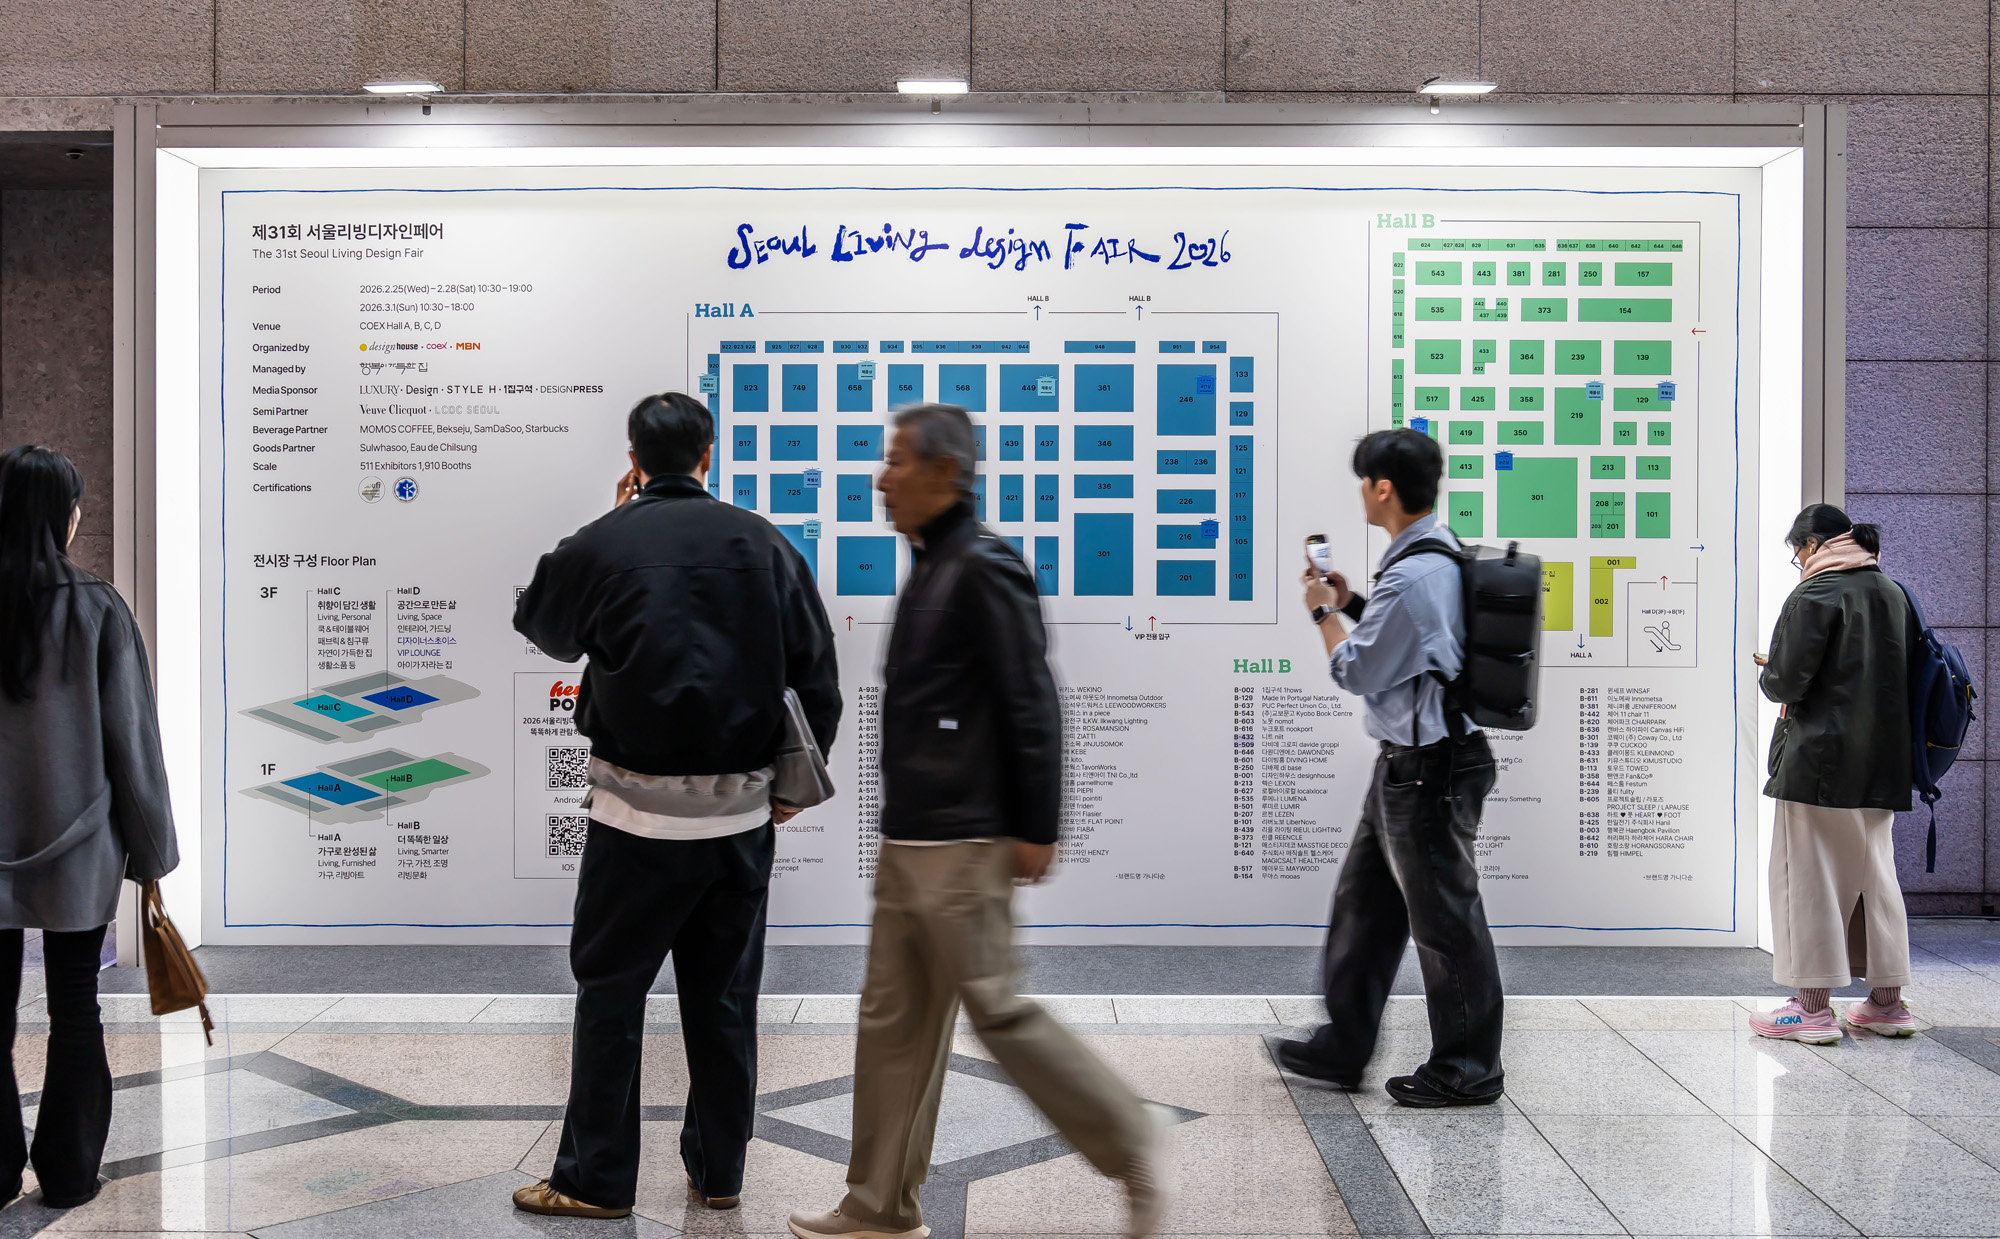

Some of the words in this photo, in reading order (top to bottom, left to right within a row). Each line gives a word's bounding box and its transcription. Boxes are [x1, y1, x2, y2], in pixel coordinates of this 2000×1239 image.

[1377, 213, 1417, 228] Hall
[1422, 214, 1434, 228] B
[252, 224, 300, 240] 제31회
[307, 223, 442, 240] 서울리빙디자인페어
[253, 249, 272, 258] The
[276, 249, 297, 258] 31st
[300, 249, 328, 258] Seoul
[333, 249, 362, 260] Living
[366, 248, 401, 260] Design
[405, 248, 423, 257] Fair
[1167, 230, 1231, 270] 2026
[360, 303, 418, 313] 2026.3.1(Sun)
[695, 303, 734, 317] Hall
[740, 304, 754, 317] A
[360, 322, 385, 330] COEX
[387, 322, 402, 330] Hall
[404, 322, 412, 331] A,
[414, 322, 422, 331] B,
[424, 322, 432, 331] C,
[253, 344, 297, 353] Organized
[299, 344, 309, 353] by
[253, 365, 293, 375] Managed
[295, 365, 306, 374] by
[253, 386, 279, 394] Media
[281, 386, 318, 396] Sponsor
[360, 385, 399, 396] LUXURY
[406, 385, 438, 396] Design
[447, 385, 483, 394] STYLE
[489, 385, 496, 393] H
[253, 407, 274, 415] Semi
[276, 407, 308, 415] Partner
[360, 405, 386, 414] Veuve
[389, 404, 426, 416] Clicquot
[435, 405, 462, 415] LCDC
[466, 405, 500, 414] SEOUL
[253, 426, 294, 436] Beverage
[360, 425, 396, 433] MOMOS
[398, 425, 435, 435] COFFEE,
[437, 425, 472, 434] Bekseju,
[474, 424, 523, 434] SamDaSoo,
[526, 424, 569, 432] Starbucks
[253, 444, 281, 452] Goods
[283, 444, 315, 452] Partner
[360, 444, 408, 453] Sulwhasoo,
[411, 443, 426, 451] Eau
[440, 443, 477, 453] Chilsung
[361, 462, 375, 470] 511
[375, 462, 416, 470] Exhibitors
[418, 462, 440, 471] 1,910
[253, 483, 311, 491] Certifications
[254, 554, 290, 567] 전시장
[293, 554, 317, 567] 구성
[321, 556, 349, 566] Floor
[353, 556, 376, 566] Plan
[261, 587, 277, 598] 3F
[334, 587, 340, 595] C
[413, 587, 420, 595] D
[318, 601, 341, 610] 취향이
[343, 601, 358, 610] 담긴
[360, 601, 376, 610] 생활
[318, 614, 340, 622] Living,
[398, 613, 419, 621] Living,
[421, 613, 442, 621] Space
[1234, 659, 1273, 673] Hall
[1279, 659, 1291, 673] B
[261, 764, 275, 775] 1F
[554, 797, 584, 805] Android
[414, 821, 420, 829] B
[333, 833, 341, 841] A
[398, 848, 420, 856] Living,
[318, 860, 340, 868] Living,
[1775, 1015, 1802, 1025] HOKA
